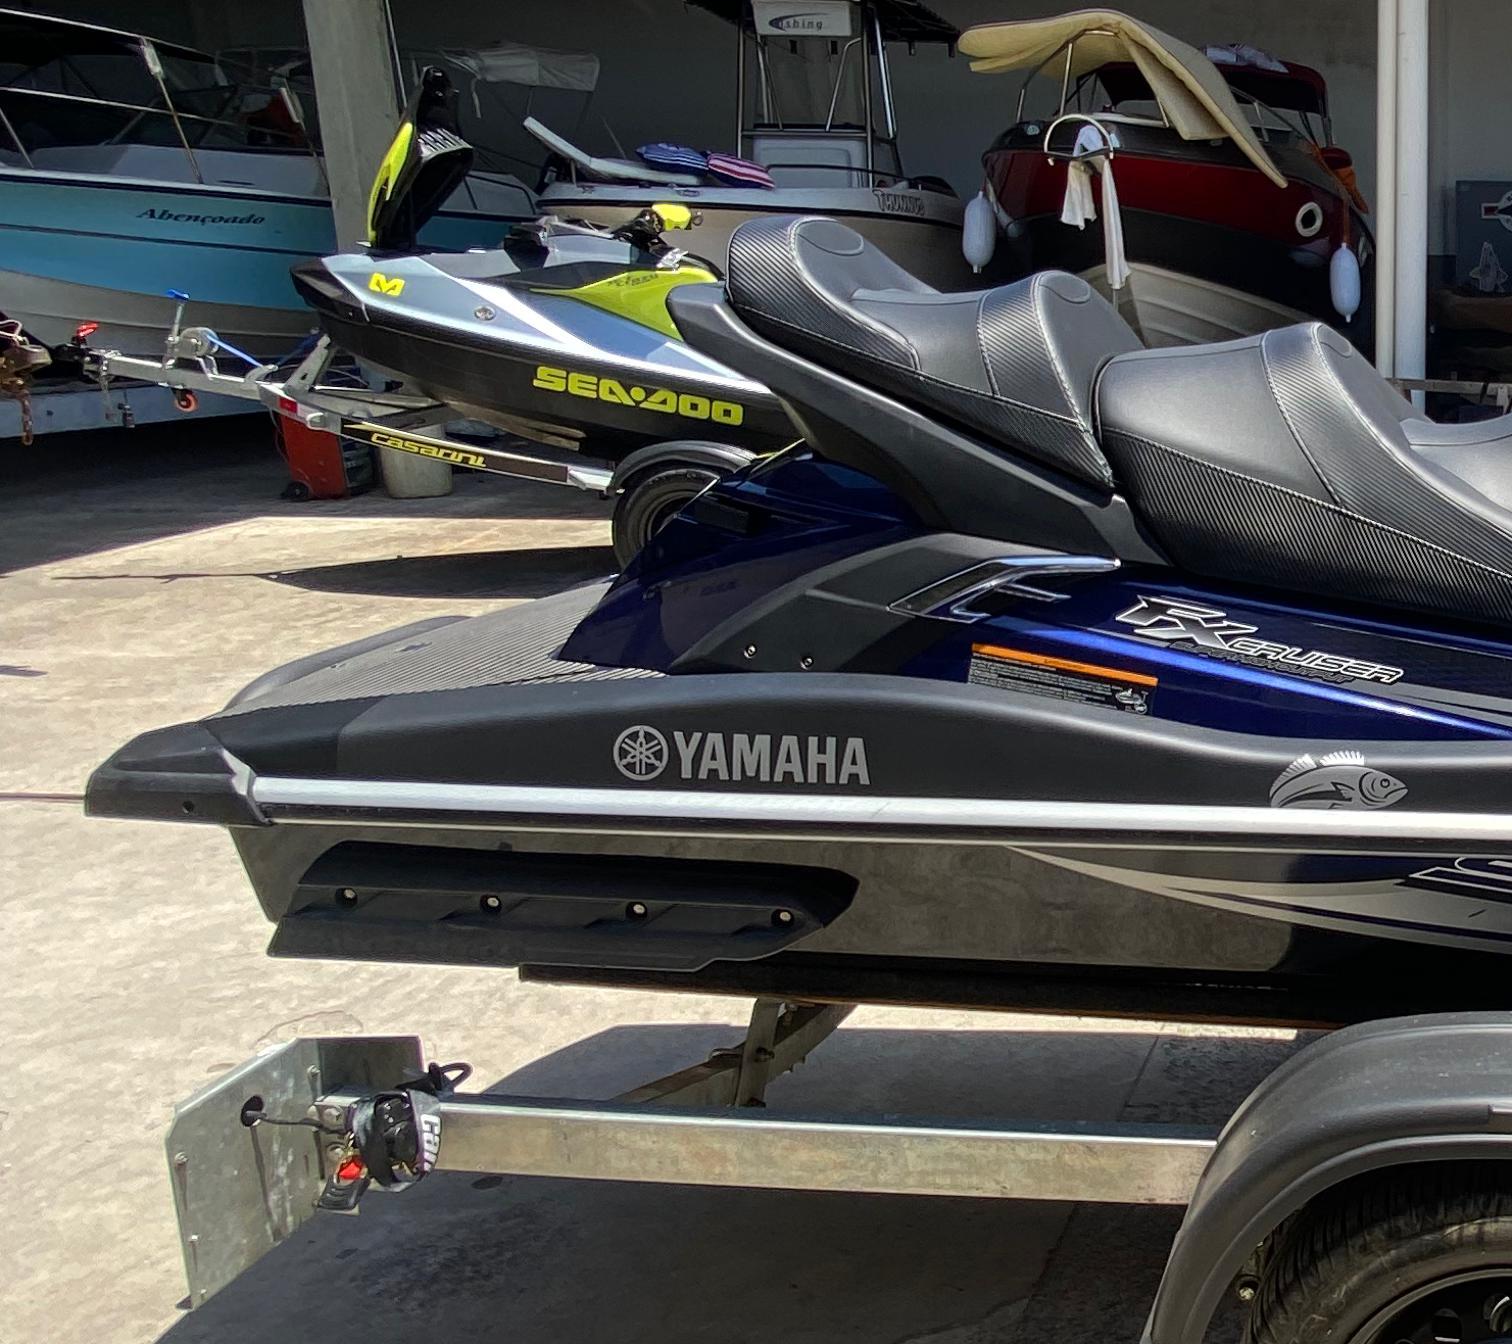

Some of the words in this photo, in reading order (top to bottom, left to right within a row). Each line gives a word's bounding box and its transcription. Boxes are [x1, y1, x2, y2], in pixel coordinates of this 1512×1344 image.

[136, 208, 265, 226] Abençoado
[1228, 637, 1404, 684] CRUISER
[673, 731, 870, 785] YAMAHA
